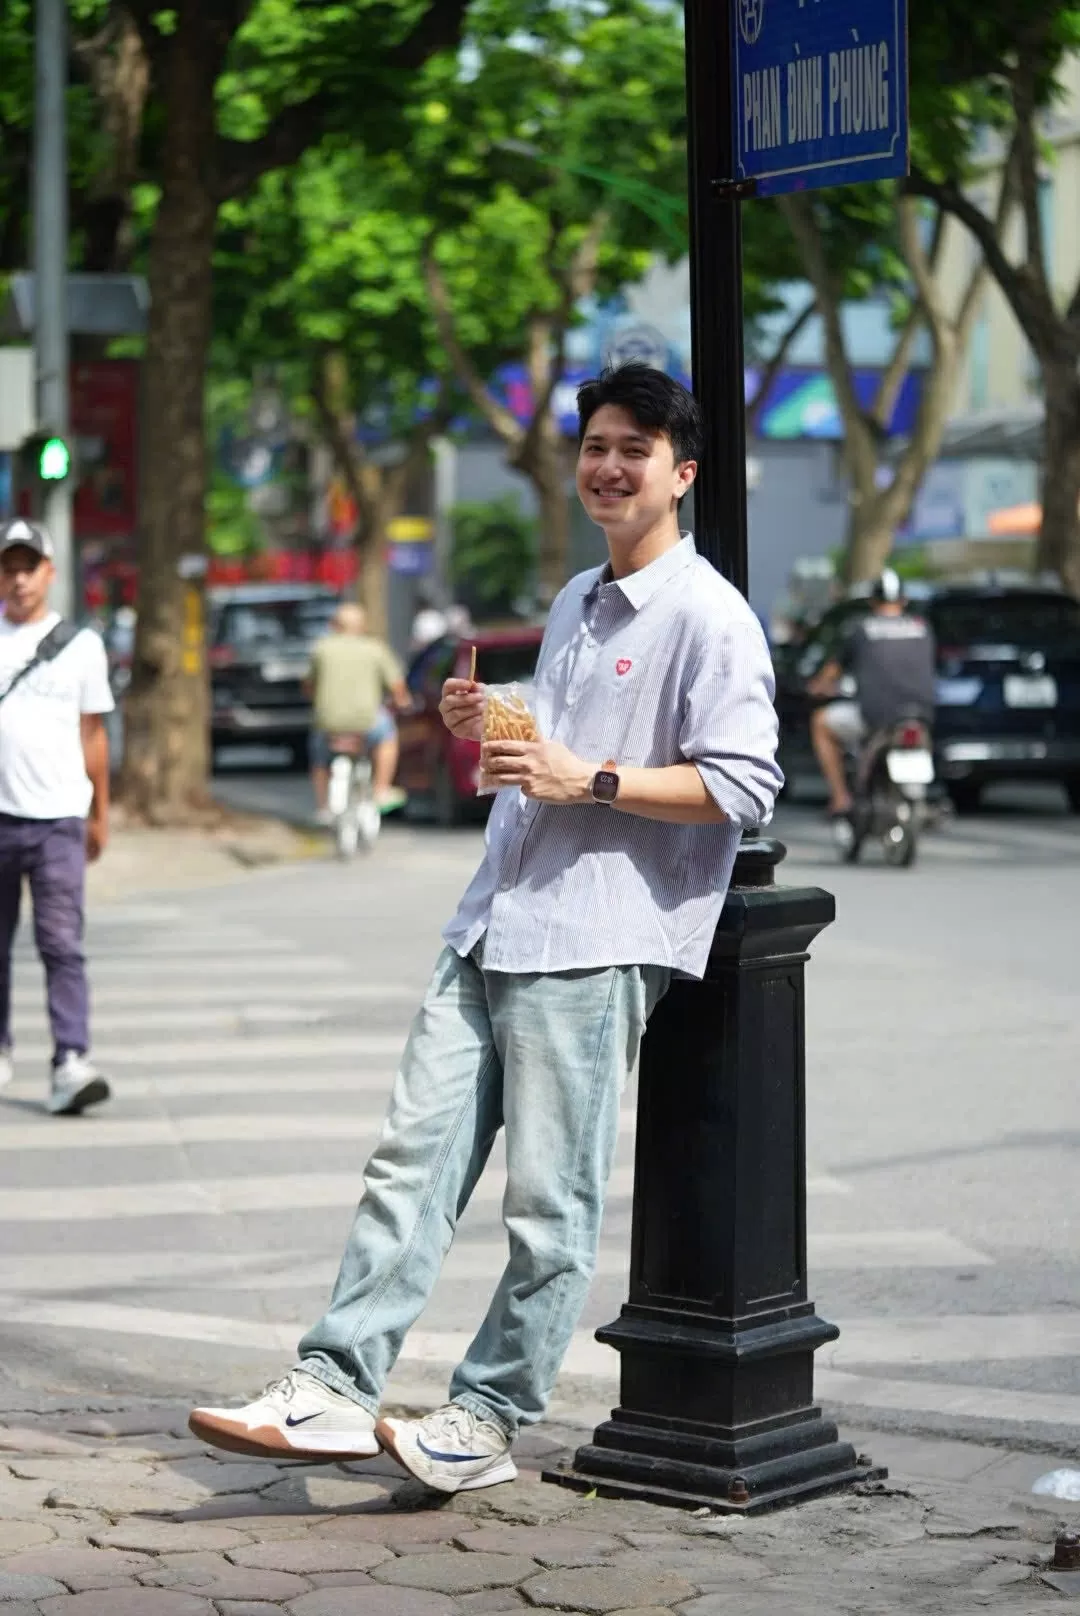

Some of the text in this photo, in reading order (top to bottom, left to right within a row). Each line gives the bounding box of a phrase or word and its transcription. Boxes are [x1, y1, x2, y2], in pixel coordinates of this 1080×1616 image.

[743, 28, 889, 153] PHAN ĐÌNH PHÙNG
